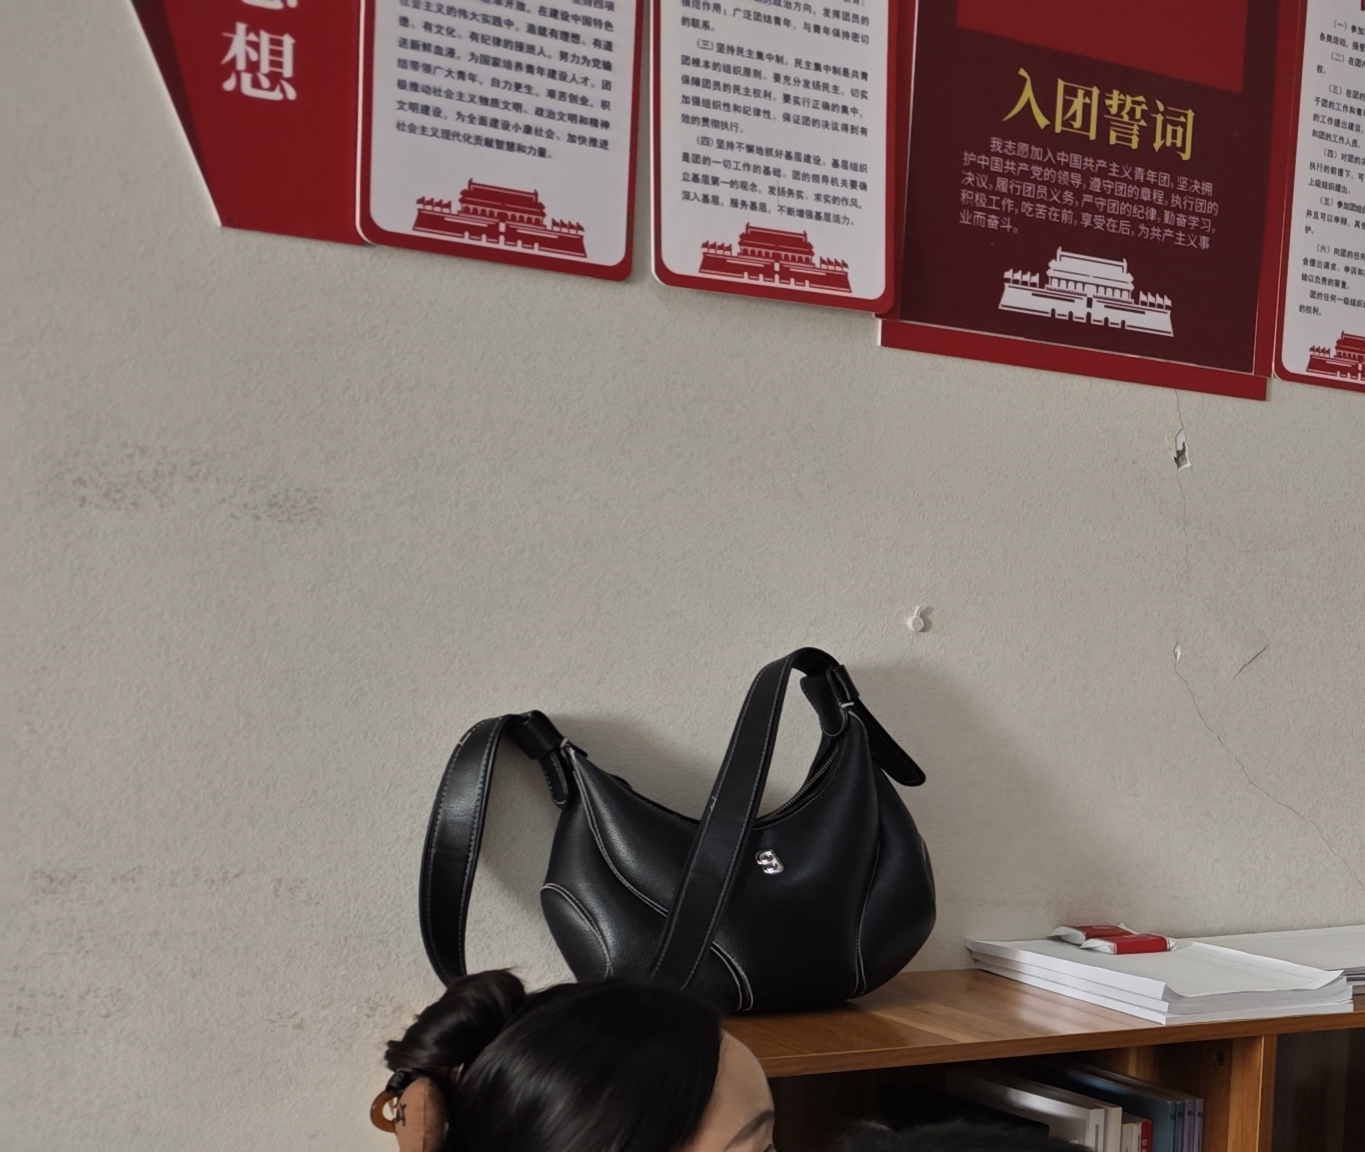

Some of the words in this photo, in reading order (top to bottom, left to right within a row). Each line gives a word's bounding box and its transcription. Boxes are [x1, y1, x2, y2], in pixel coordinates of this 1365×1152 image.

[220, 0, 298, 101] 想
[1001, 67, 1195, 161] 入团誓词
[959, 209, 1019, 234] 业而奋斗。
